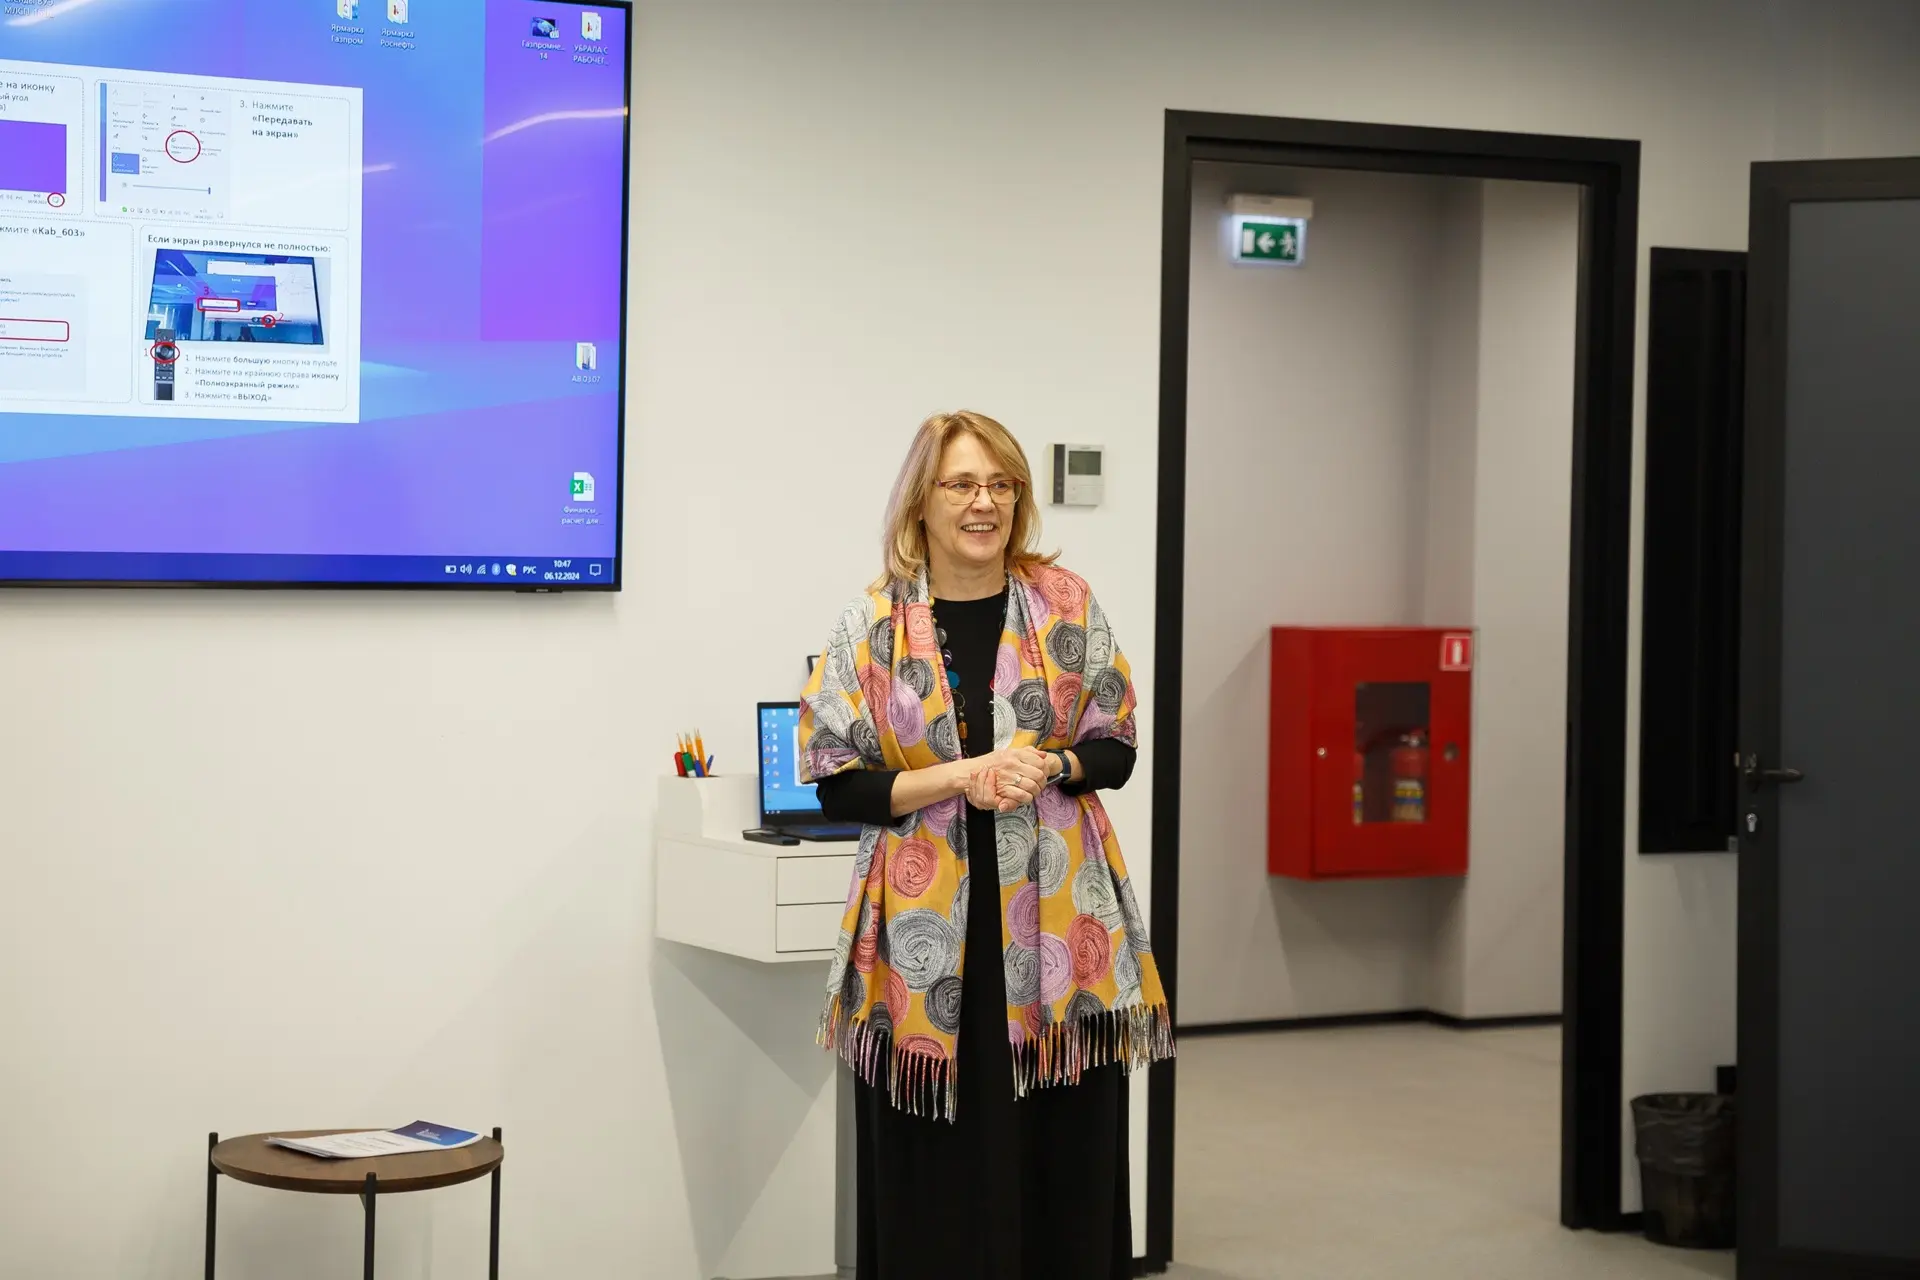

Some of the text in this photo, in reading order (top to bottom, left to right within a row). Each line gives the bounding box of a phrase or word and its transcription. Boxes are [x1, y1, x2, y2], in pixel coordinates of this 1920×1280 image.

[331, 24, 364, 34] Ярмарка
[381, 28, 414, 38] Ярмарка
[331, 35, 363, 45] Газпром
[380, 39, 415, 49] Роснефть
[574, 45, 602, 53] УБРАЛА
[21, 83, 55, 94] иконку
[240, 100, 294, 111] 3. Нажмите
[252, 115, 313, 126] «Передавать
[266, 130, 299, 139] экран»
[32, 227, 85, 238] «Kab_603»
[148, 234, 170, 243] Если
[172, 237, 200, 246] экран
[202, 239, 262, 249] развернулся
[278, 243, 331, 252] полностью:
[195, 355, 231, 363] Нажмите
[233, 356, 270, 365] большую
[272, 359, 299, 367] кнопку
[195, 368, 231, 376] Нажмите
[244, 368, 281, 378] крайнюю
[311, 373, 340, 381] иконку
[195, 379, 265, 389] «Полноэкранный
[195, 392, 231, 400] Нажмите
[233, 393, 272, 402] «ВЫХОД»
[553, 559, 572, 568] 10:47
[522, 565, 537, 574] РУС
[543, 571, 580, 581] 06.12.2024
